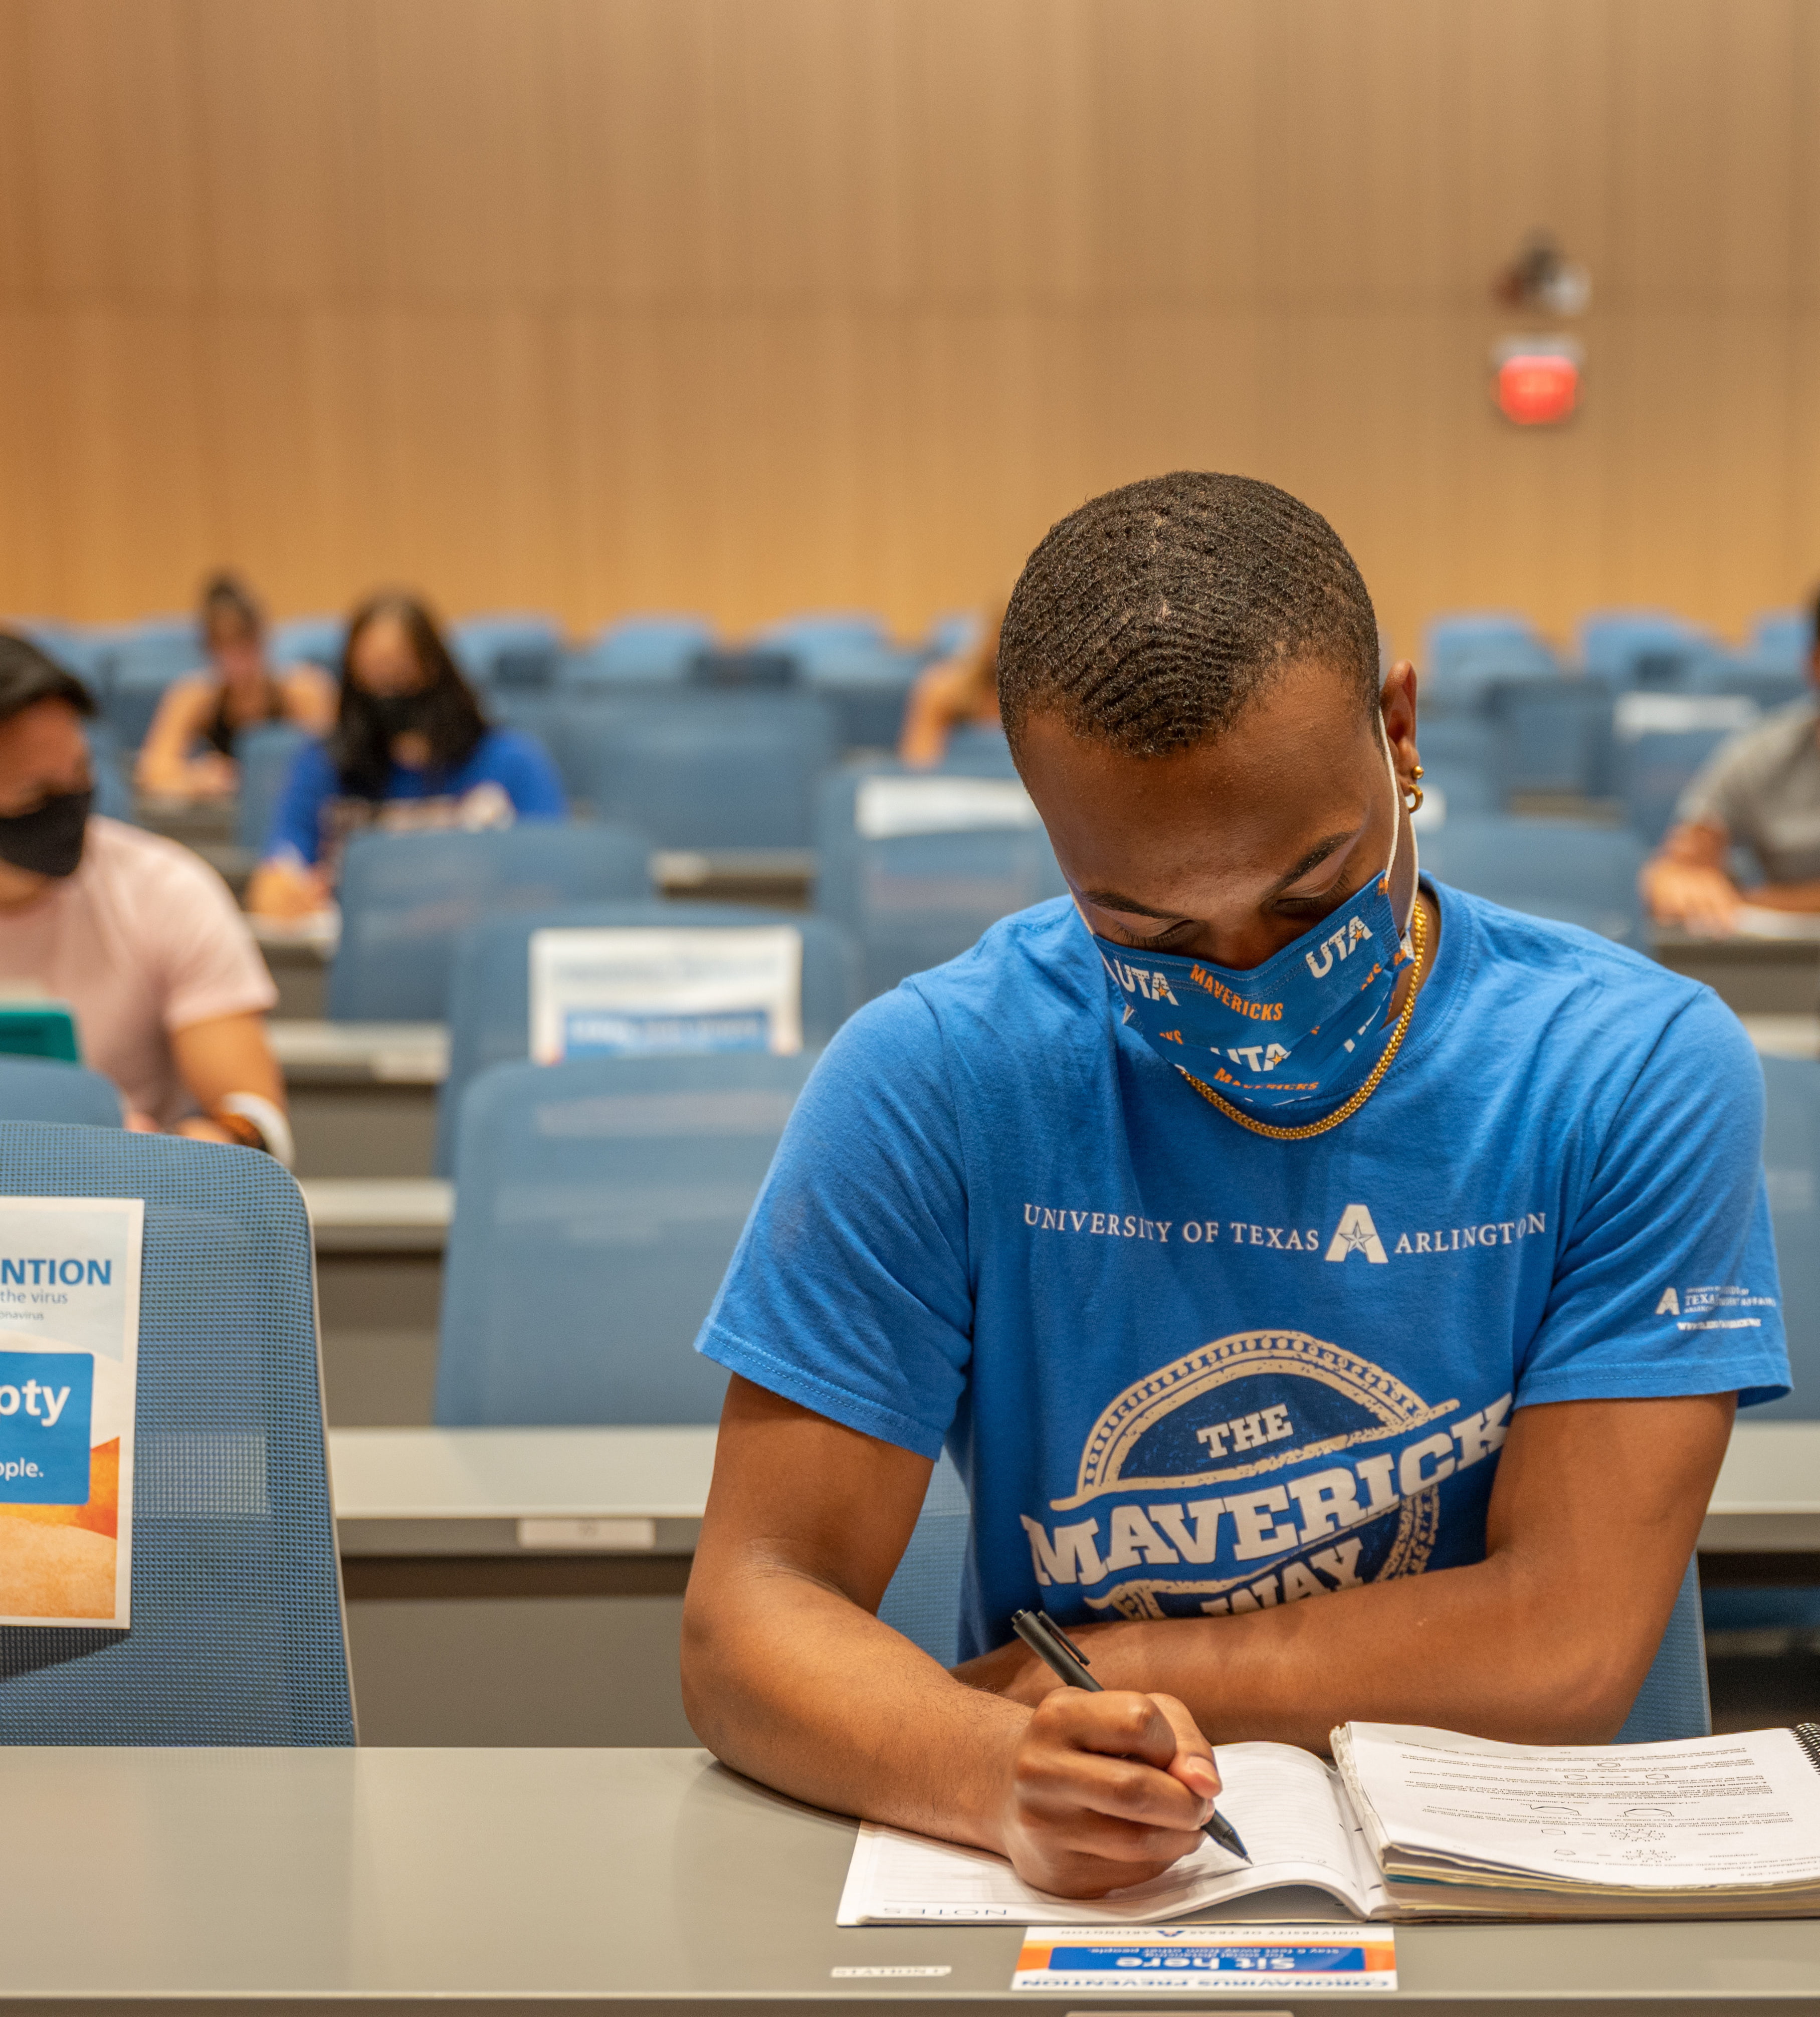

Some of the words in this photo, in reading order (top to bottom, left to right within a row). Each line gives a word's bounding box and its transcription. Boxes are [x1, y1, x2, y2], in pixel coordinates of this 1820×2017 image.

[1306, 916, 1373, 978] UTA
[1114, 958, 1179, 1006] UTA
[1189, 963, 1284, 1021] MAVERICKS
[1024, 1203, 1172, 1243] UNIVERSITY
[1182, 1221, 1219, 1243] OF
[1231, 1222, 1319, 1251] TEXAS
[1324, 1202, 1389, 1264] A
[1394, 1212, 1546, 1253] ARLINGTON
[0, 1288, 26, 1304] the
[31, 1289, 69, 1304] virus
[1, 1258, 112, 1286] NTION
[1684, 1294, 1716, 1307] TEXA
[1197, 1403, 1294, 1458] THE
[1021, 1392, 1513, 1586] MAVERICK
[1200, 1537, 1364, 1616] WAY
[884, 1908, 1007, 1916] NOTES
[1116, 1957, 1220, 1970] here
[1235, 1957, 1295, 1970] Sit
